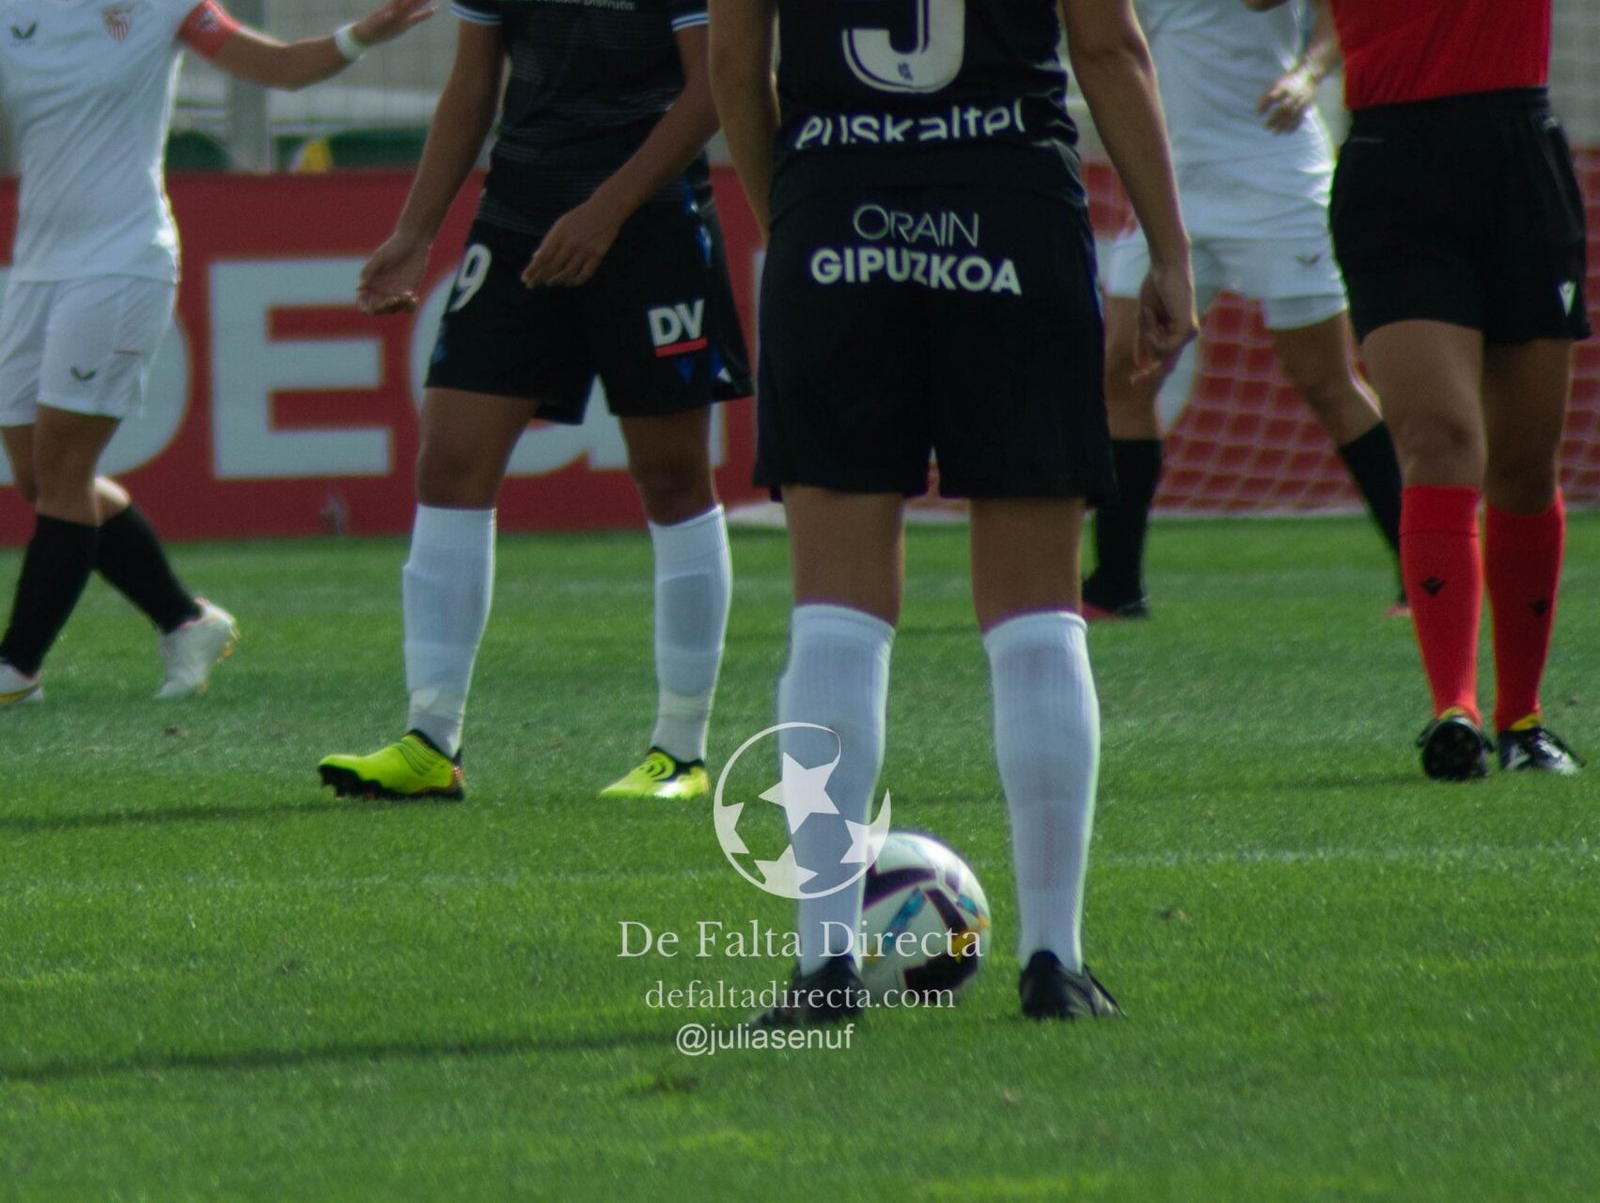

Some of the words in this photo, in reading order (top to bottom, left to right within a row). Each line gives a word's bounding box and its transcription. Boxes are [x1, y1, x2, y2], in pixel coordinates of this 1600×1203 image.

[853, 203, 979, 248] ORAIN
[448, 242, 493, 313] 9
[811, 247, 1022, 296] GIPUZKOA
[648, 298, 705, 347] DV
